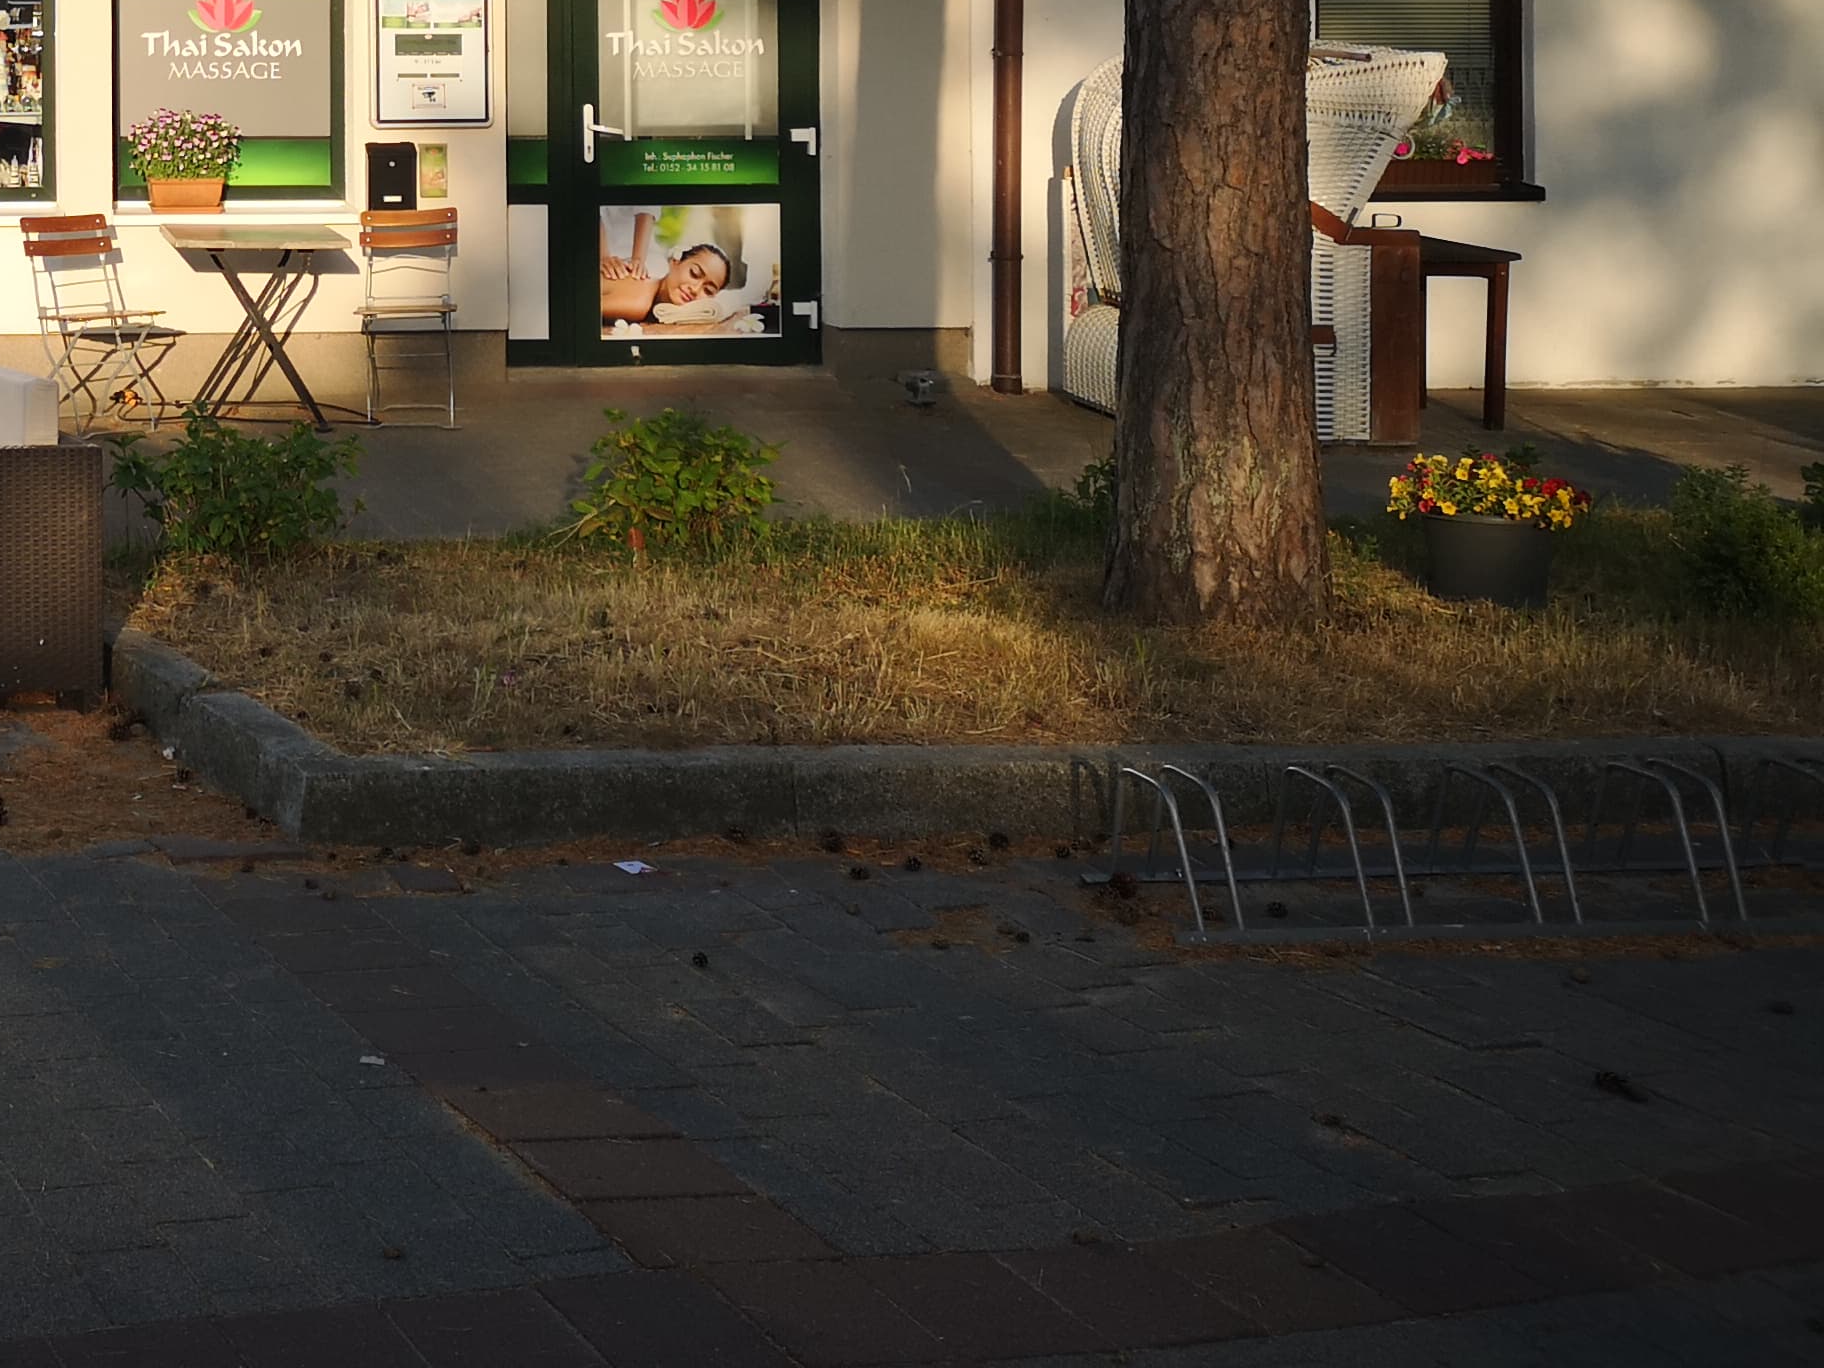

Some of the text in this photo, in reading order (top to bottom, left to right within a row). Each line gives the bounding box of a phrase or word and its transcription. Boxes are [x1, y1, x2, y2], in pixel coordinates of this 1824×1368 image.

[140, 30, 303, 57] Thai Sakon
[605, 30, 766, 57] Thai Sakon
[167, 60, 282, 80] MASSAGE
[632, 60, 745, 80] MASSAGE
[707, 151, 734, 160] Fischer
[659, 162, 681, 172] 0152
